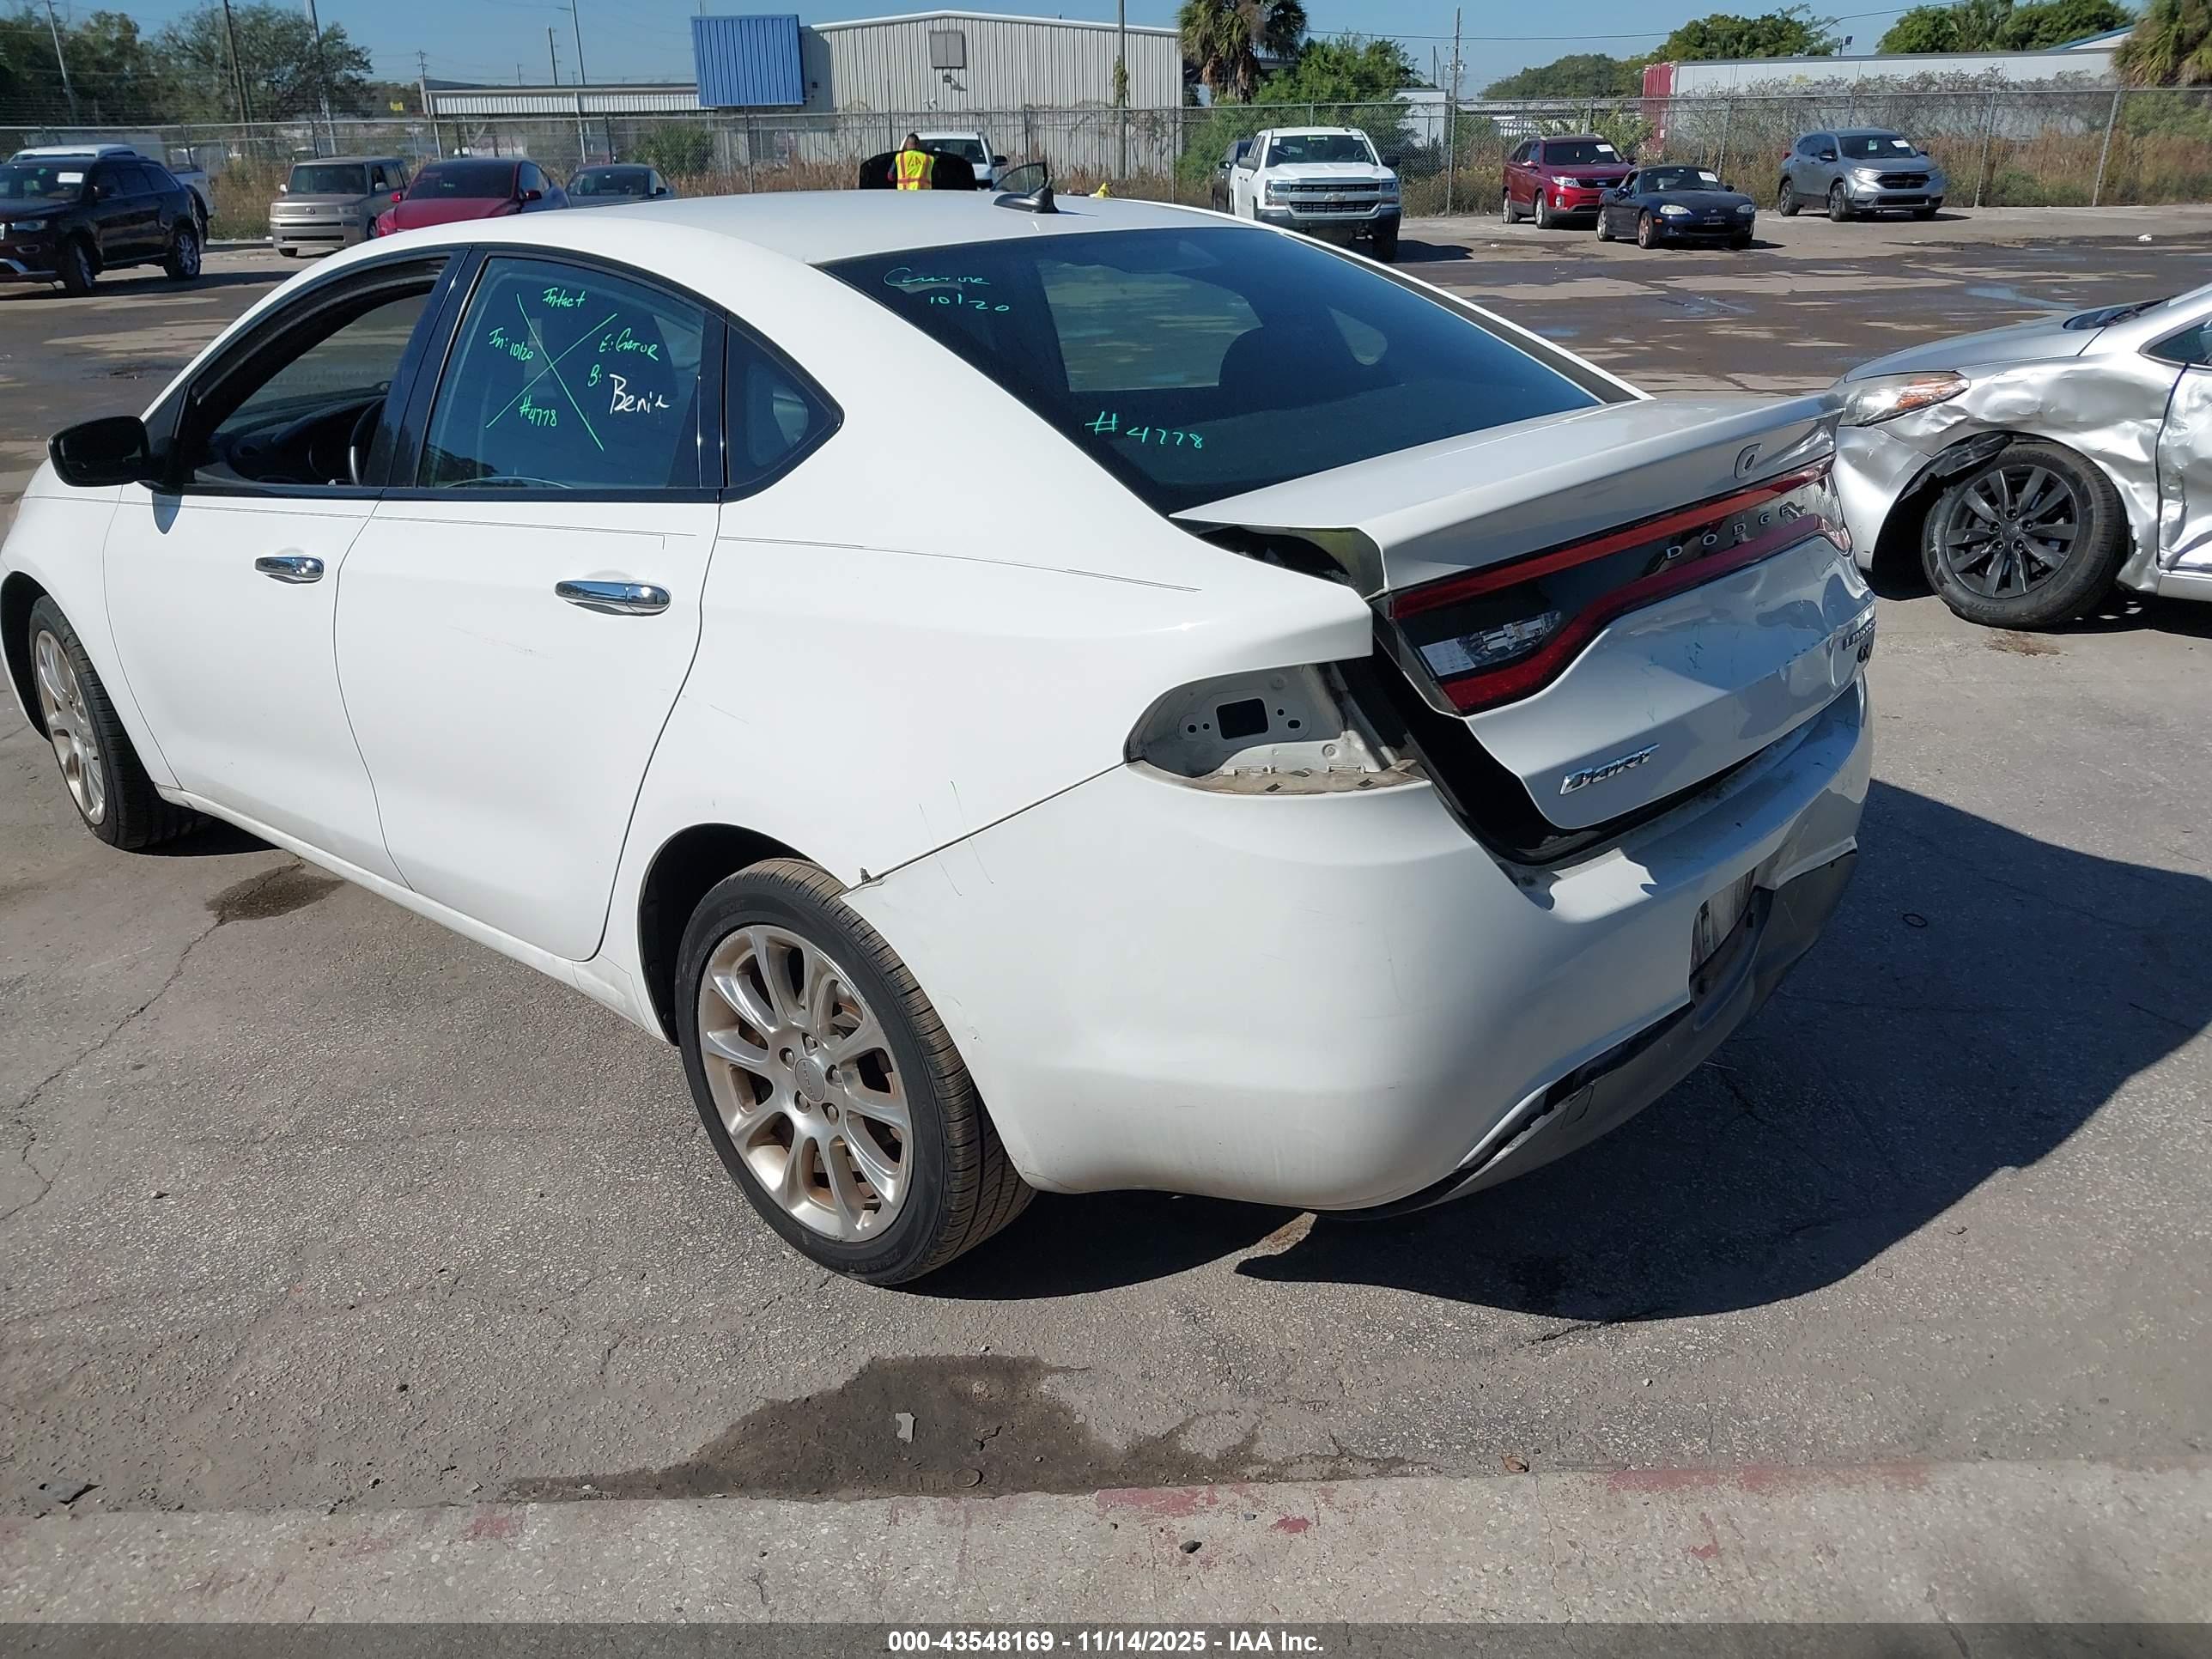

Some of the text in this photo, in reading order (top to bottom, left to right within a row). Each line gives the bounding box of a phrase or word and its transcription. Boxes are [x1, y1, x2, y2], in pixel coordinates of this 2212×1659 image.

[929, 293, 1011, 313] 10/20
[508, 341, 535, 362] 10/20
[519, 394, 558, 428] #4778
[1665, 504, 1792, 560] DODGE
